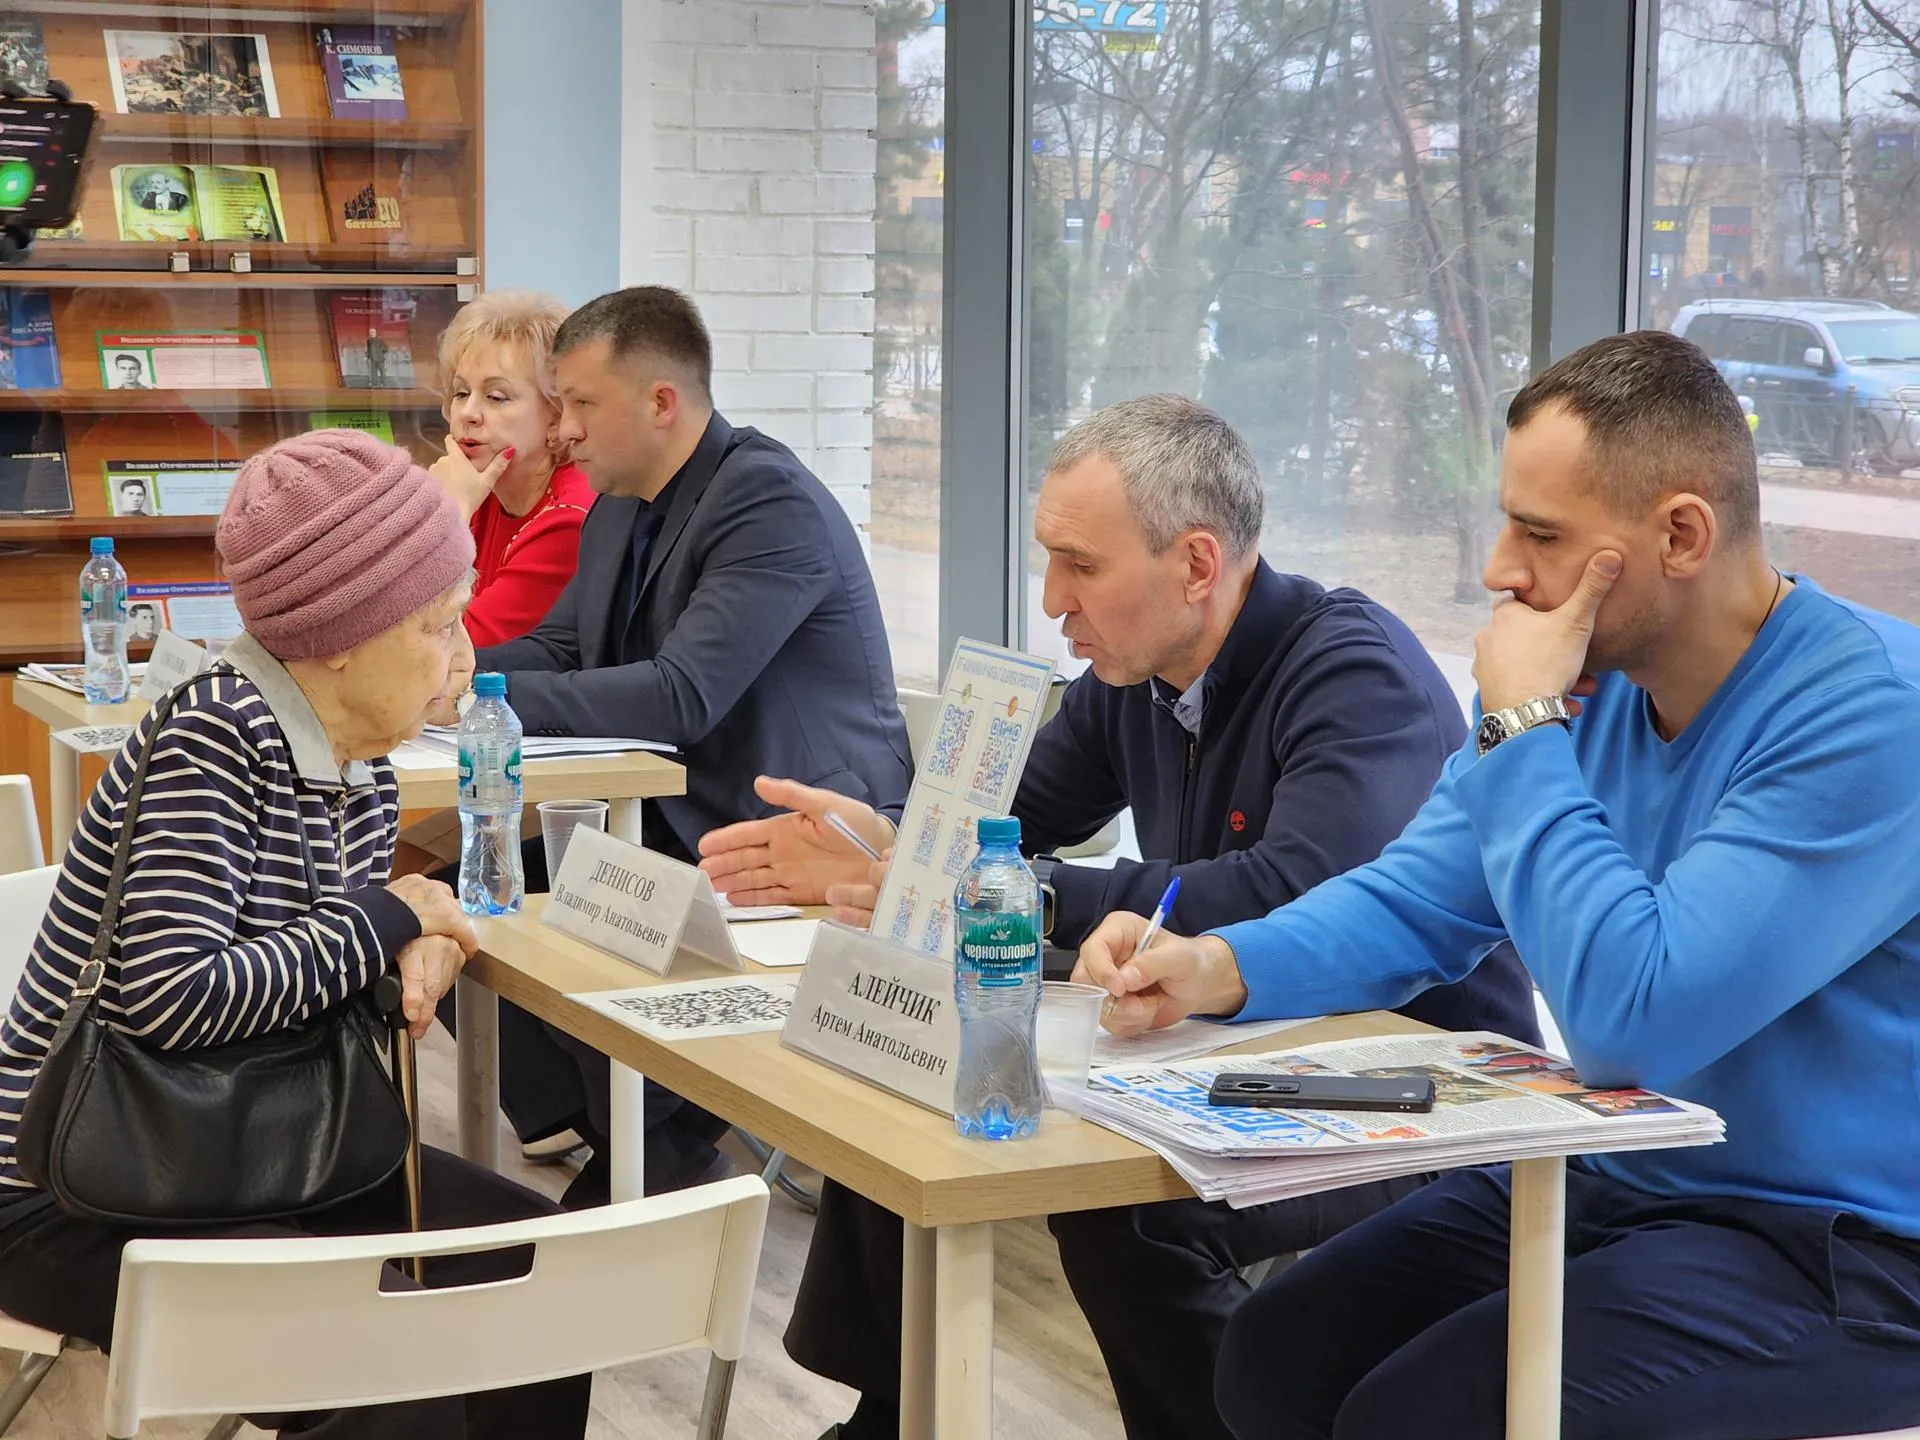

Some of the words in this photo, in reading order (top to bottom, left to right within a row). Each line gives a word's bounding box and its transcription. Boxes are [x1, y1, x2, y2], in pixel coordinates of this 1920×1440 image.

[325, 44, 336, 54] К.
[337, 44, 383, 54] СИМОНОВ
[589, 859, 657, 902] ДЕНИСОВ
[554, 883, 602, 923] Владимир
[601, 905, 669, 949] Анатольевич
[964, 943, 1037, 961] черноголовка
[847, 971, 942, 1026] АЛЕЙЧИК
[811, 1003, 854, 1037] Артем
[853, 1021, 948, 1076] Анатольевич
